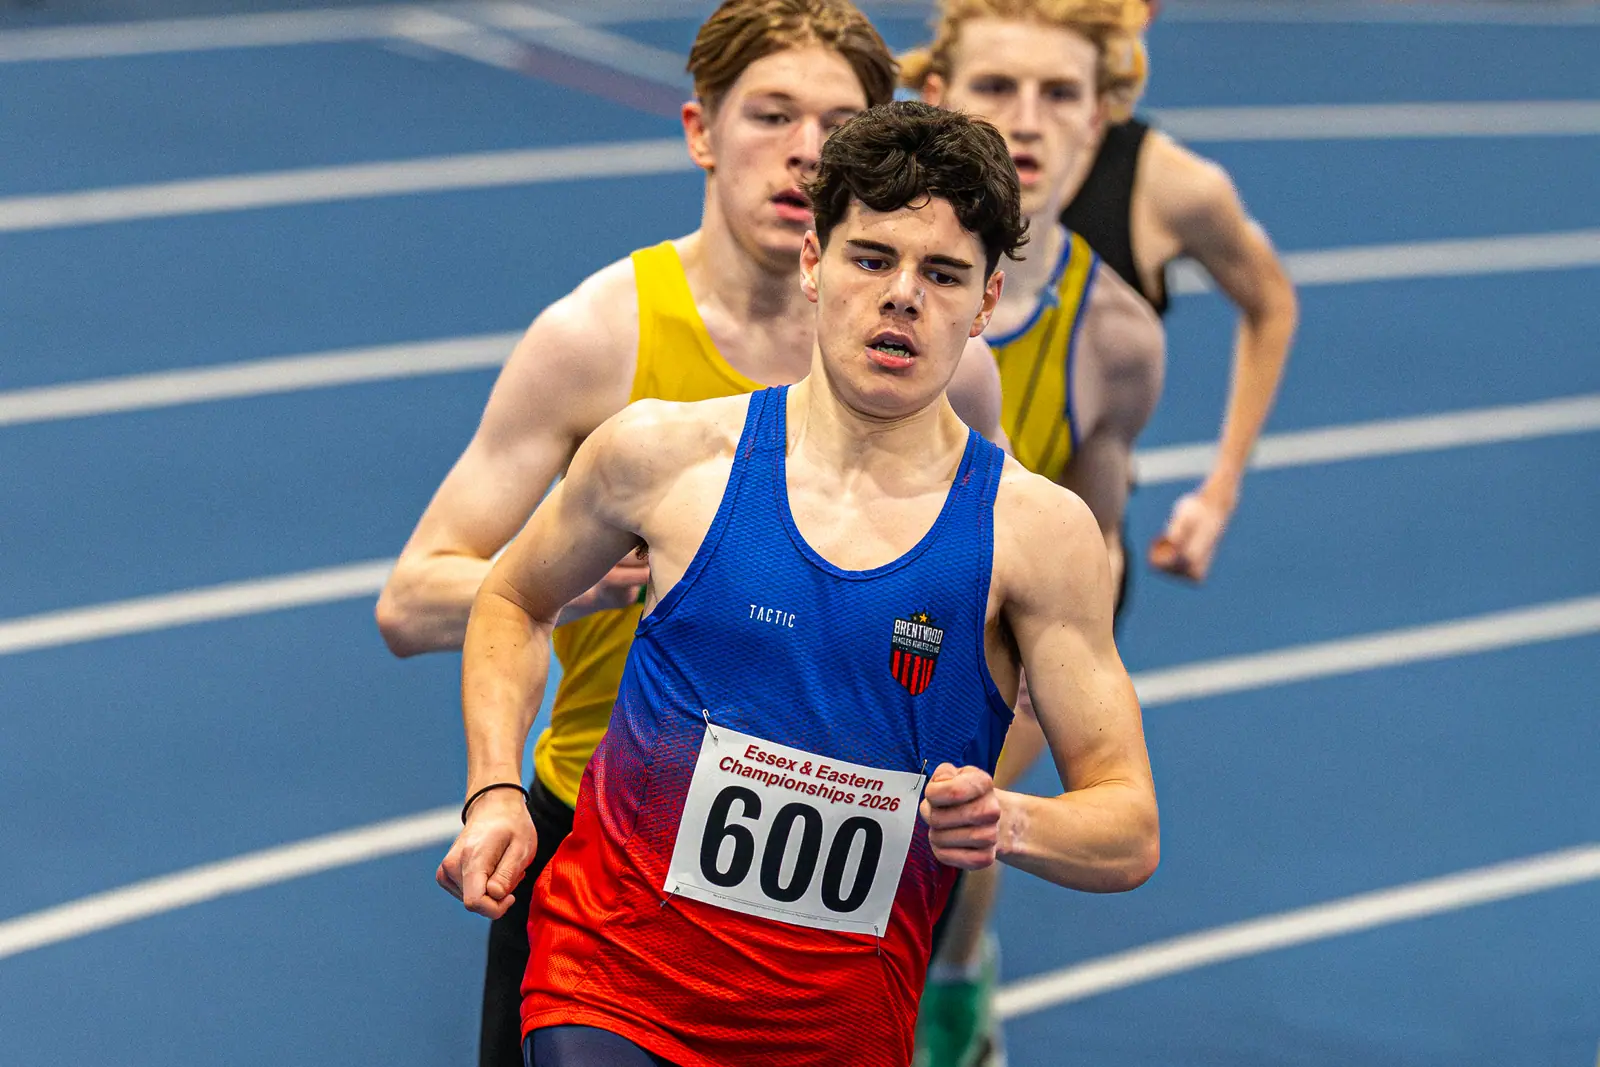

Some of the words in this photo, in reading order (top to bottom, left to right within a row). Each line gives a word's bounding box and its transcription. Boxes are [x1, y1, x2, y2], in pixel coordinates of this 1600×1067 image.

[749, 604, 796, 628] TACTIC
[893, 619, 944, 645] BRENTWOOD
[718, 756, 856, 805] Championships
[858, 792, 901, 812] 2026
[743, 744, 799, 772] Essex
[799, 761, 812, 777] &
[815, 764, 885, 792] Eastern
[699, 785, 884, 914] 600
